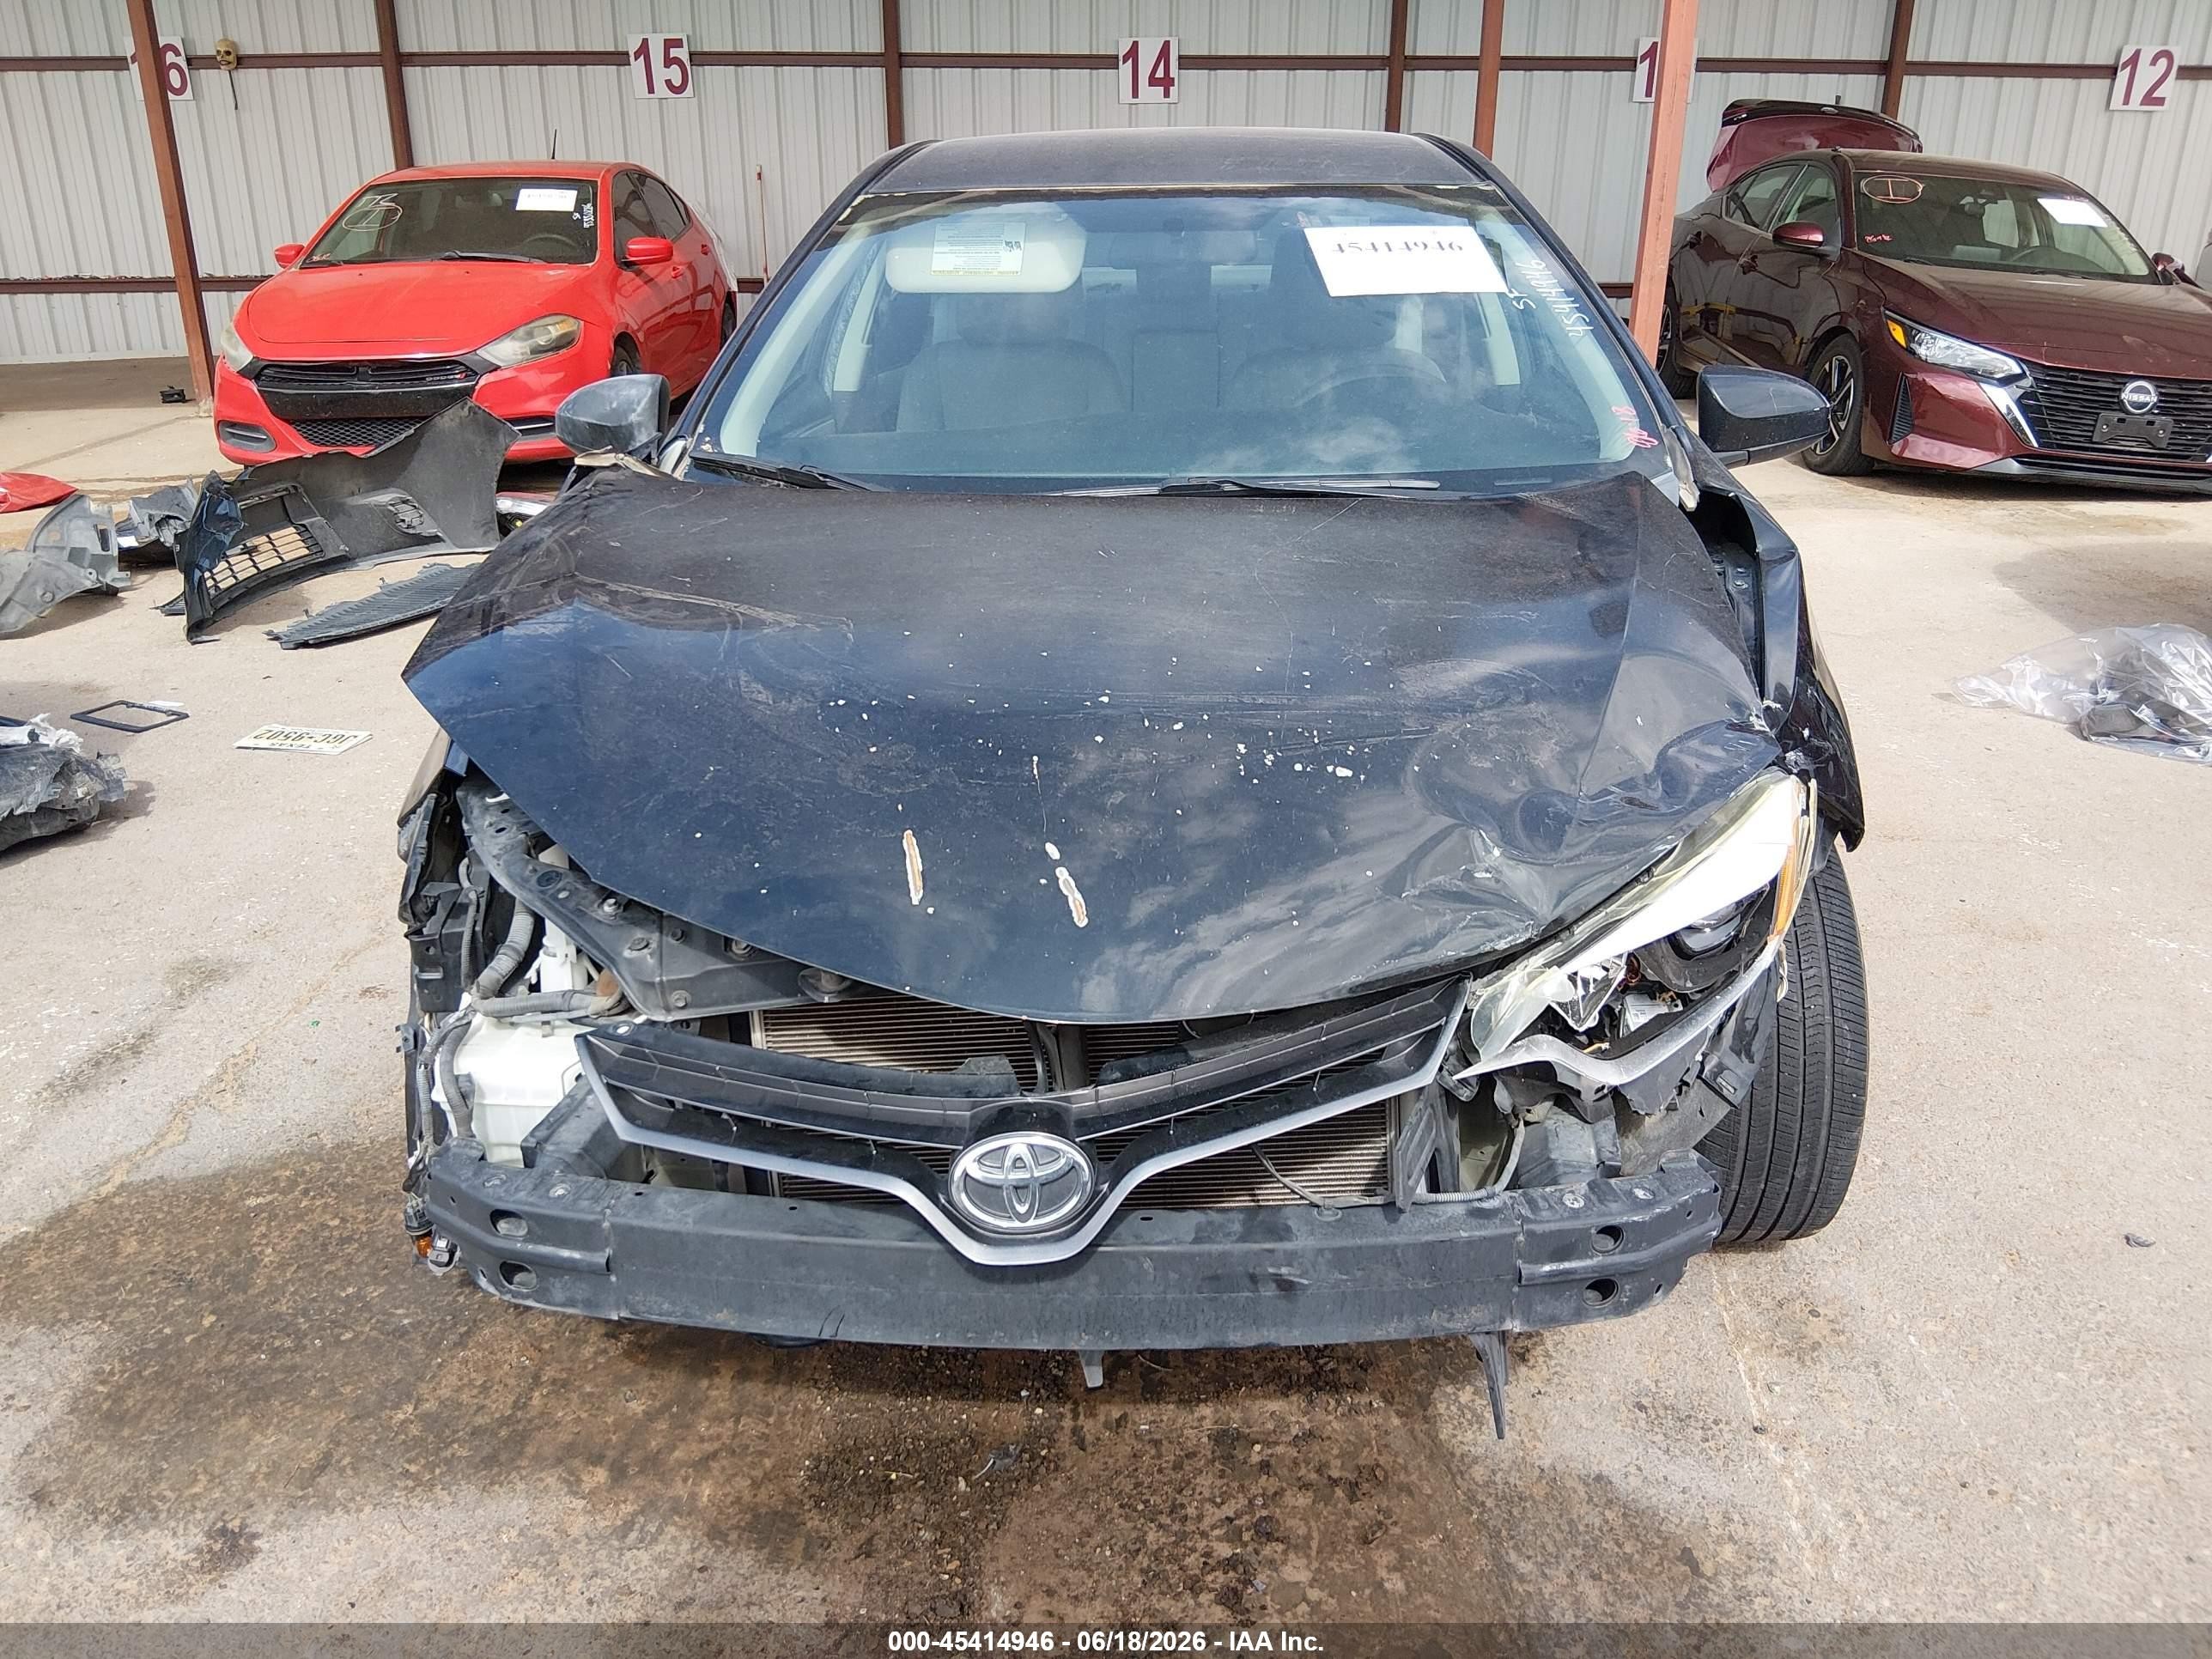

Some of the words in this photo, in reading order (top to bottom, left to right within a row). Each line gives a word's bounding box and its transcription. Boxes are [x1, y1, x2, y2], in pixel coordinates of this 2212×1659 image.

[130, 44, 188, 96] 6
[634, 38, 690, 94] 15
[1121, 40, 1175, 99] 14
[1639, 41, 1659, 97] 1
[2119, 48, 2174, 106] 12
[1515, 259, 1594, 337] 45414946
[2121, 392, 2158, 403] NISSAN
